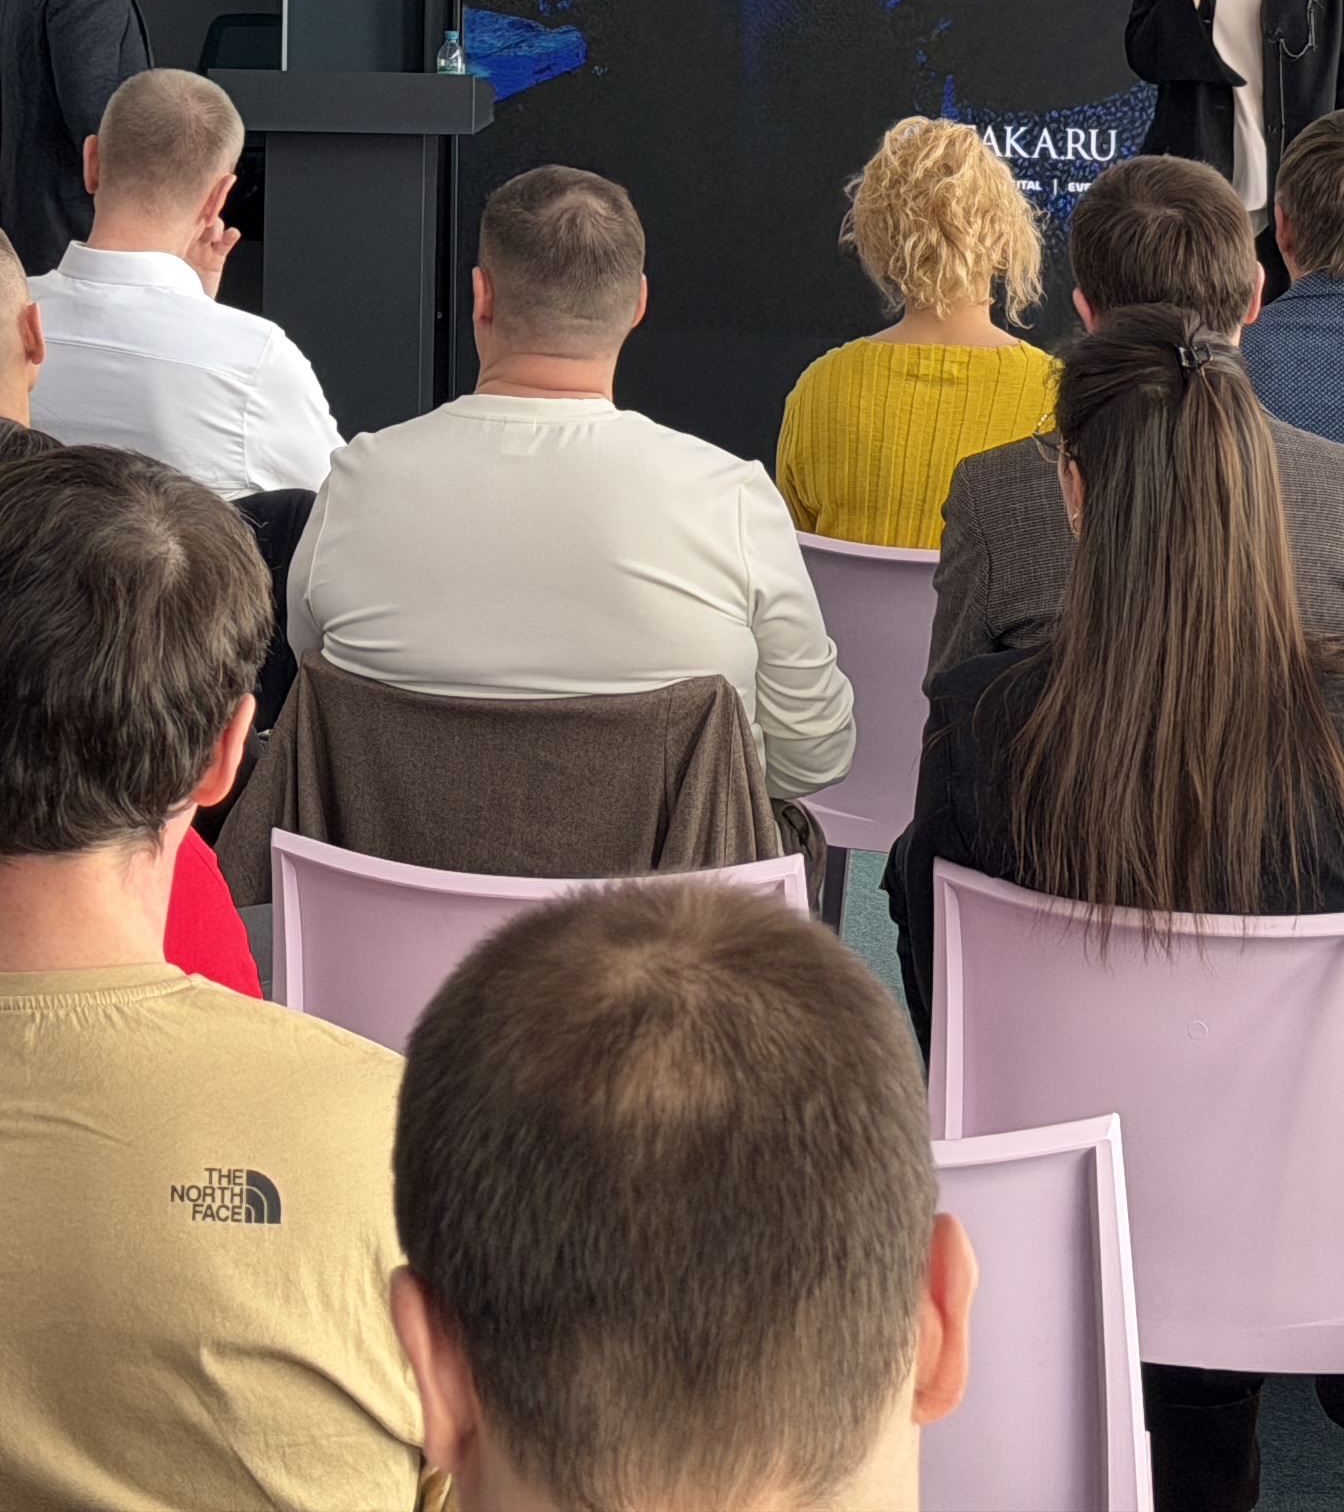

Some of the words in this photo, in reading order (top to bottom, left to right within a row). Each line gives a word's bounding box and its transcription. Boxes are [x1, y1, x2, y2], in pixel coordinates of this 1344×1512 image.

[204, 1167, 245, 1186] THE
[170, 1185, 244, 1204] NORTH
[191, 1203, 243, 1223] FACE
